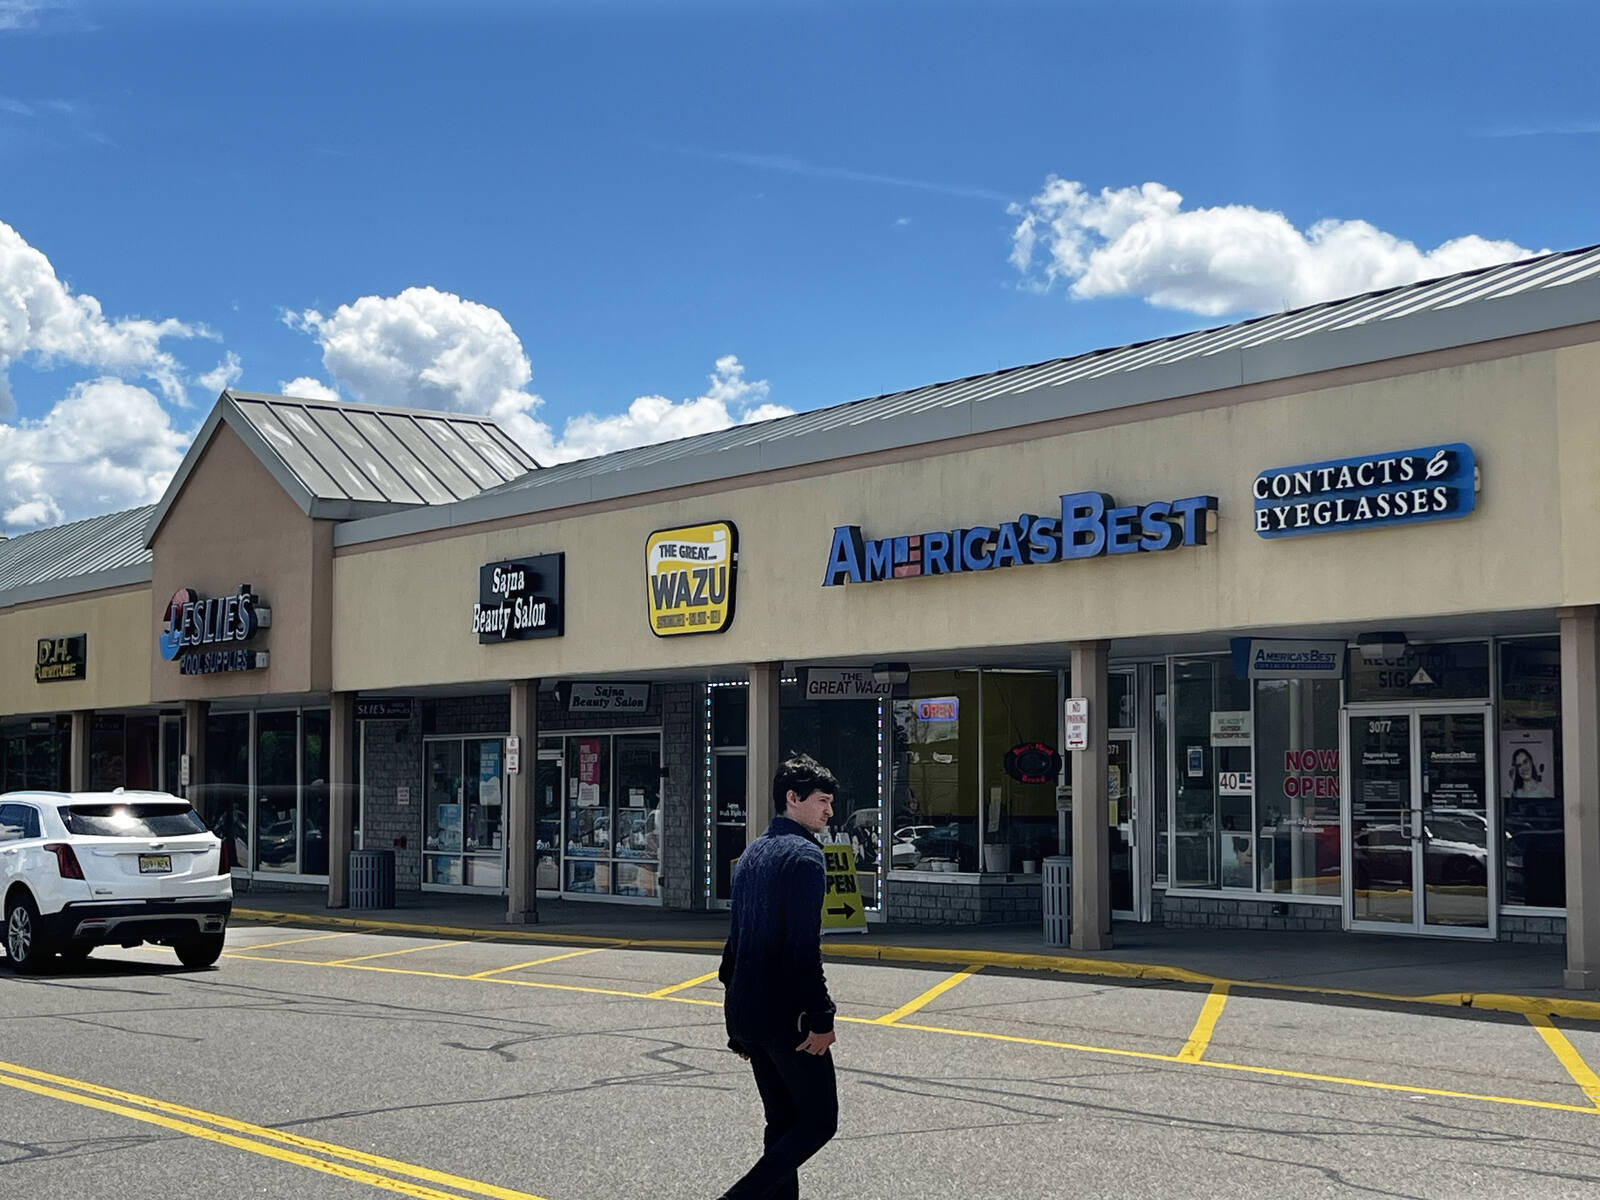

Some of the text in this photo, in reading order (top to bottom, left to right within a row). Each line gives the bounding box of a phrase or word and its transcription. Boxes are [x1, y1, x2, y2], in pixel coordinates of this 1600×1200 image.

[1253, 450, 1449, 500] CONTACTS &
[1255, 486, 1448, 531] EYEGLASSES
[822, 490, 1215, 587] AMERICA'S BEST
[659, 544, 677, 558] THE
[492, 567, 525, 598] Sajna
[651, 565, 726, 610] WAZU
[472, 595, 546, 639] Beauty Salon
[181, 649, 249, 674] POOL SUPPLIES
[1256, 648, 1337, 662] AMERICA'S BEST
[840, 672, 863, 681] THE
[594, 686, 624, 698] Sajna
[809, 681, 891, 694] GREAT WAZU
[573, 696, 643, 709] Beauty Salon
[921, 704, 954, 718] OPEN
[1072, 702, 1080, 712] NO
[1368, 720, 1392, 734] 3077
[1108, 745, 1119, 754] 071
[1284, 750, 1339, 772] NOW
[1220, 773, 1237, 790] 40
[1283, 776, 1340, 798] OPEN
[824, 852, 849, 872] ELI
[825, 874, 857, 894] PEN
